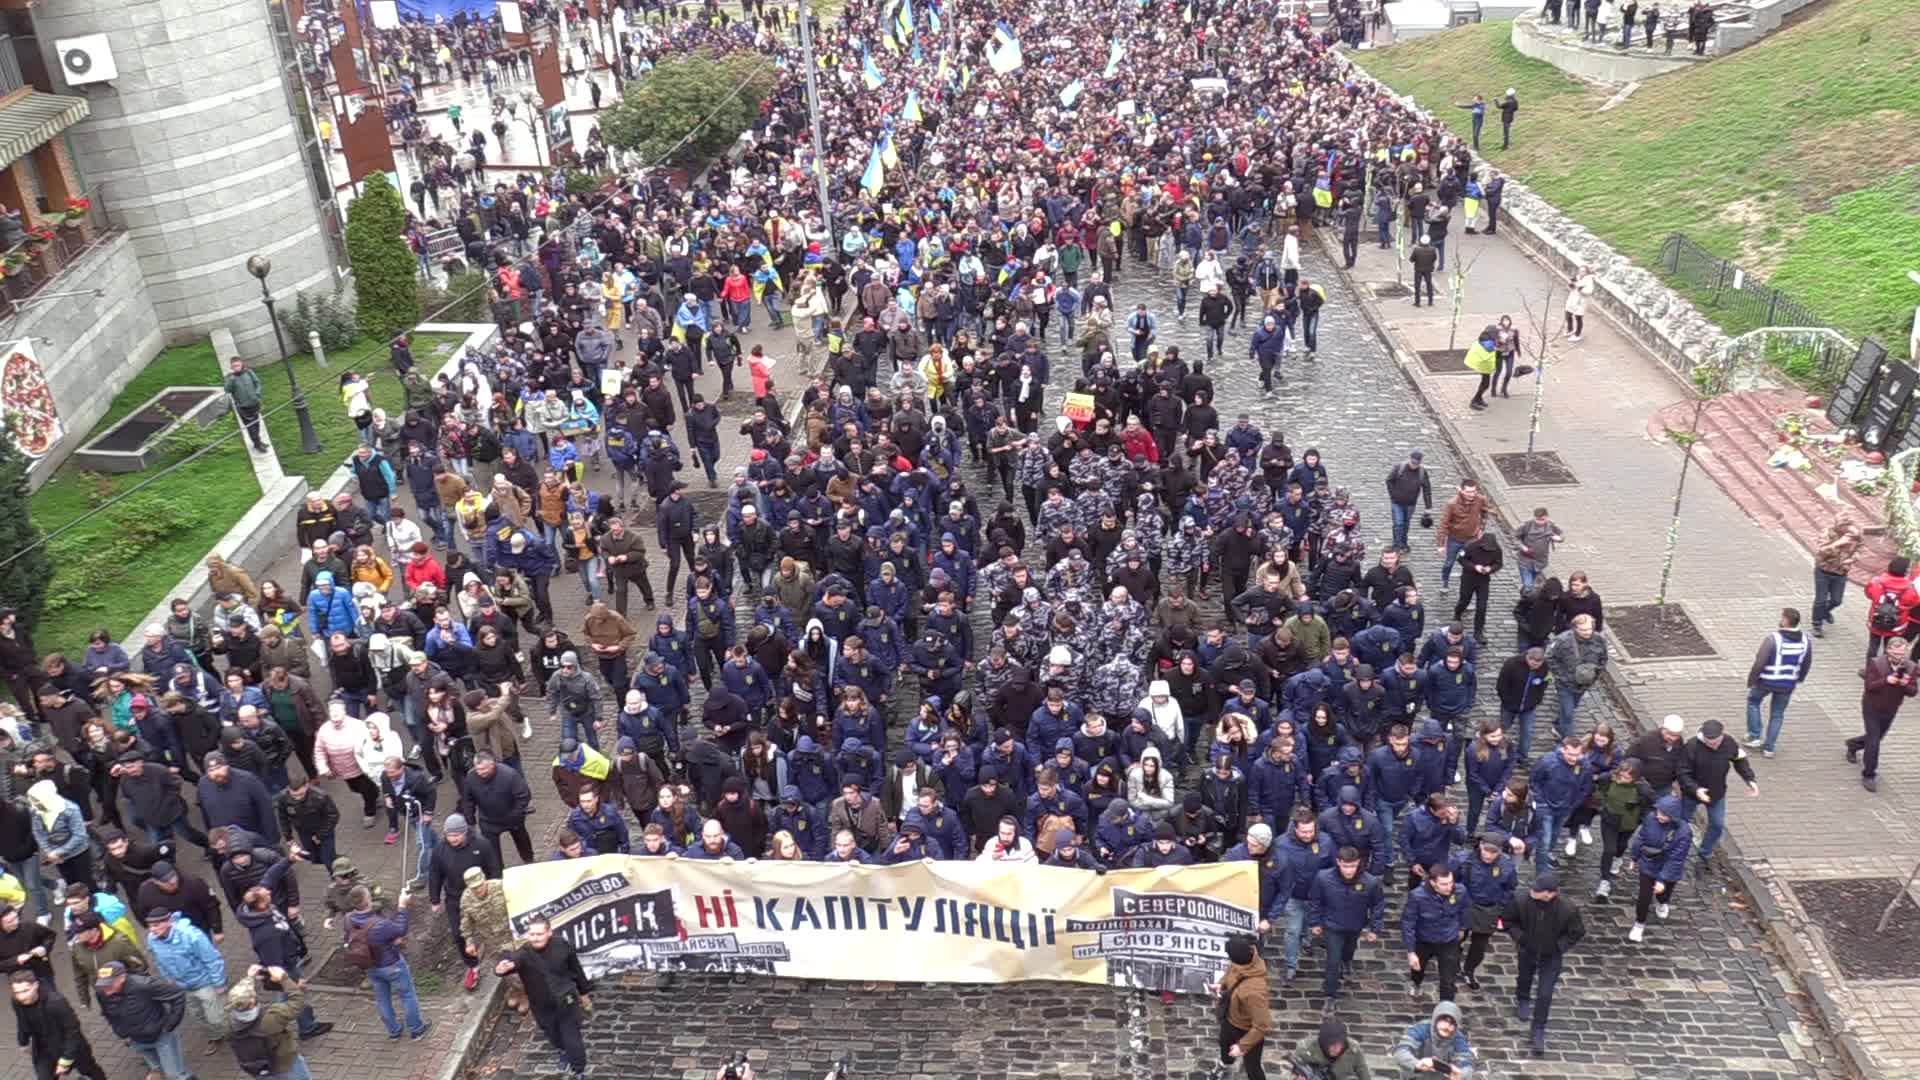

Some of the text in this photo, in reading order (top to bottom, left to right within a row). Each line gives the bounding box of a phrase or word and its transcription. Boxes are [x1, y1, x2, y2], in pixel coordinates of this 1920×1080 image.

[563, 901, 658, 949] НСЬК
[695, 889, 1057, 949] НІ КАПІТУЛЯЦІЇ
[1113, 934, 1221, 952] СЛОВ'ЯНСЬ
